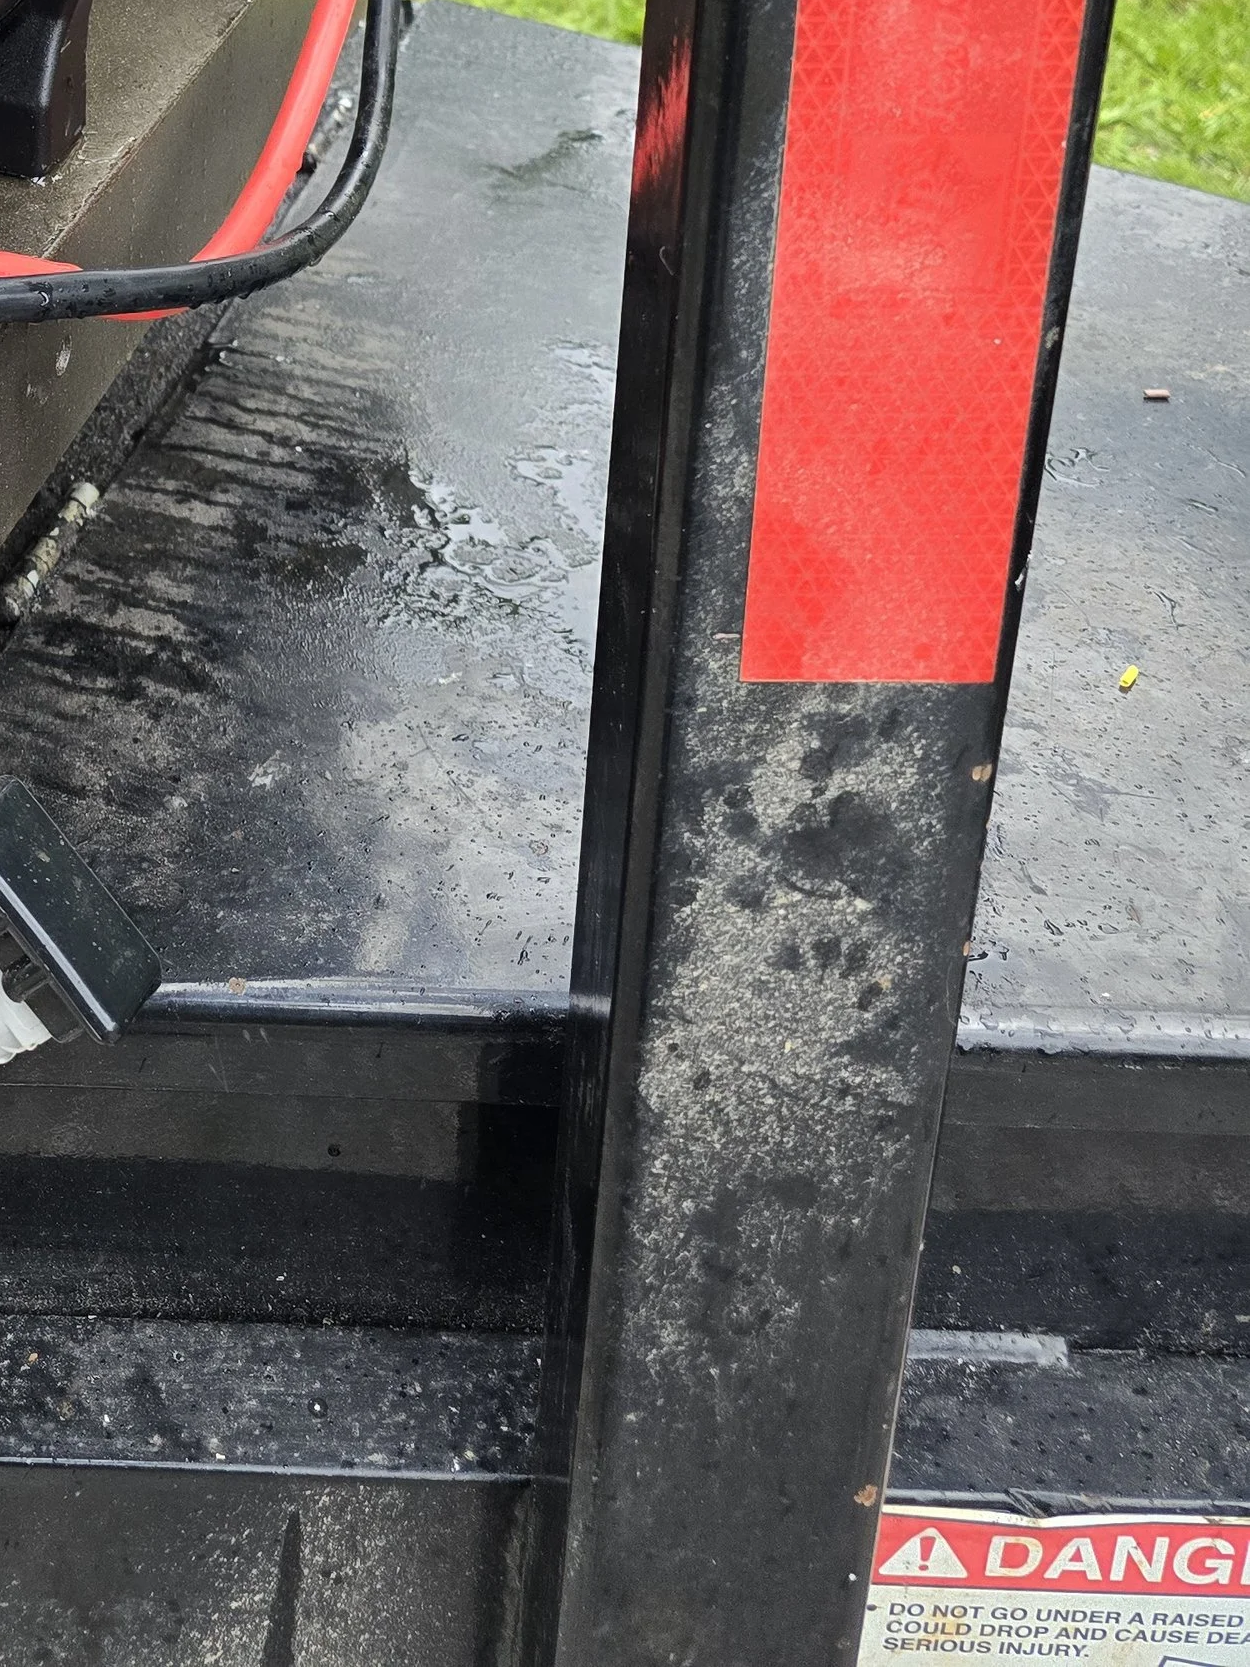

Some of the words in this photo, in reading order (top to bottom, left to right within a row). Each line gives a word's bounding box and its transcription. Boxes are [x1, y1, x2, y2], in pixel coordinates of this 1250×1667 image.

[985, 1536, 1250, 1585] DANG
[888, 1602, 925, 1617] DO
[932, 1604, 985, 1619] NOT
[990, 1607, 1028, 1621] GO
[1036, 1608, 1121, 1624] UNDER
[1127, 1612, 1145, 1625] A
[1151, 1612, 1244, 1628] RAISED
[886, 1620, 972, 1636] COULD
[979, 1624, 1049, 1638] DROP
[1054, 1627, 1107, 1641] AND
[1114, 1628, 1199, 1644] CAUSE
[882, 1637, 992, 1654] SERIOUS
[998, 1641, 1089, 1658] INJURY.
